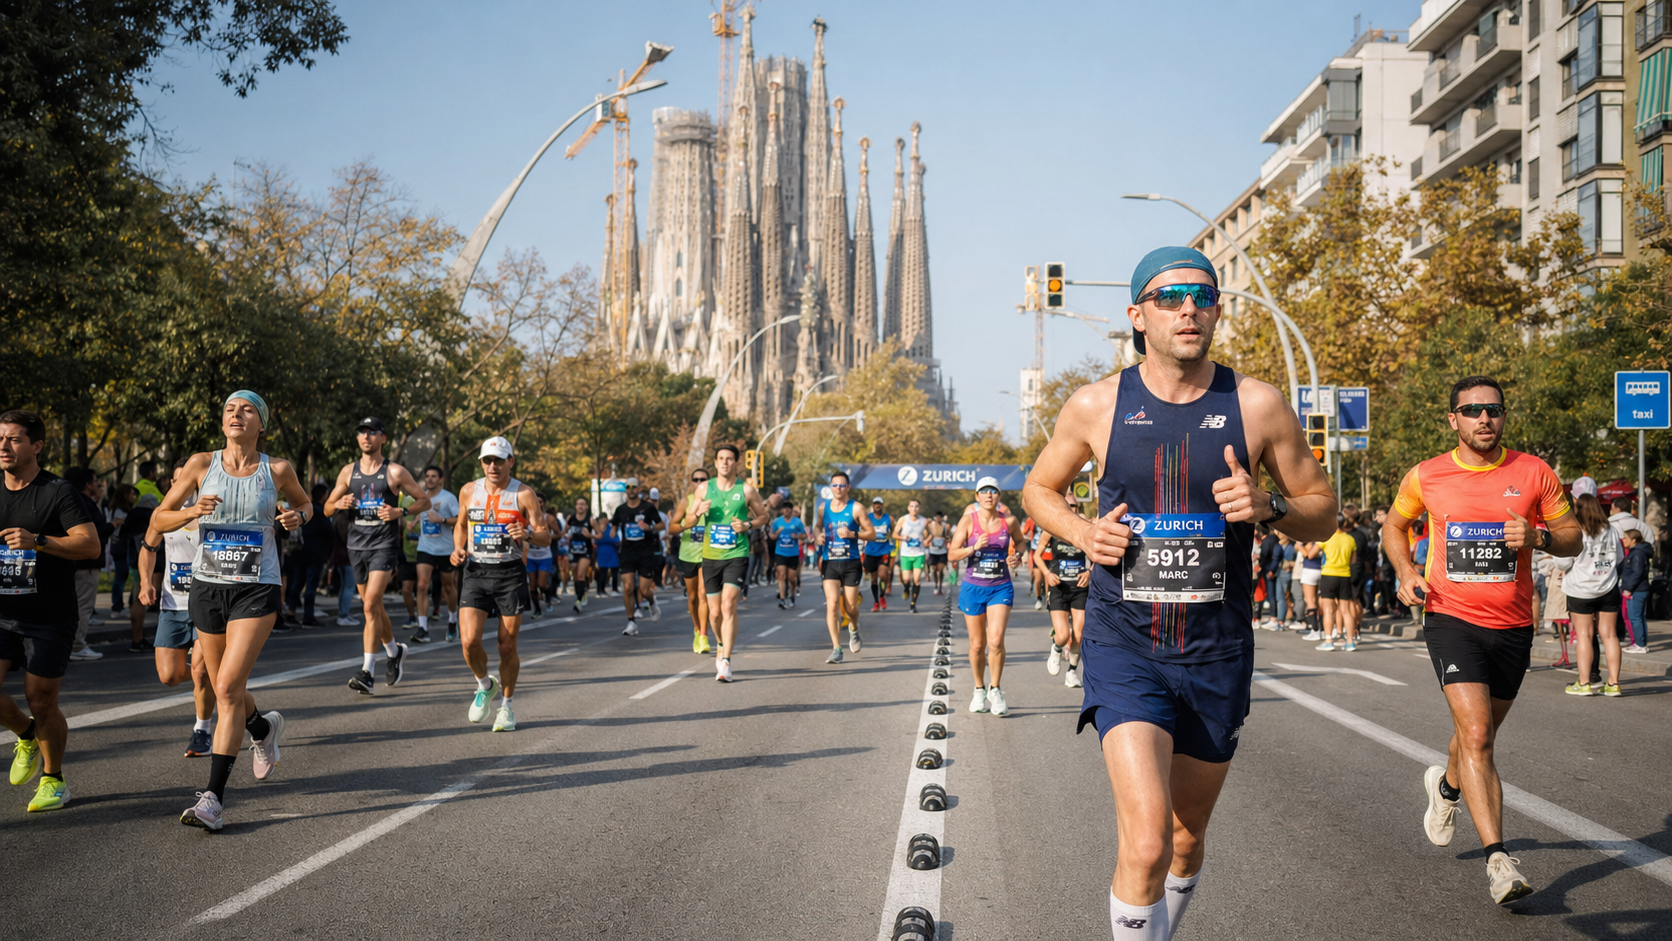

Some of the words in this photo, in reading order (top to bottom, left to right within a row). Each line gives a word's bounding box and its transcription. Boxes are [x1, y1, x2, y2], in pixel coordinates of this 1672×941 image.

[1632, 409, 1654, 419] taxi
[922, 470, 976, 482] ZURICH
[1154, 520, 1203, 531] ZURICH
[1467, 528, 1502, 536] ZURICH
[1147, 548, 1200, 567] 5912
[1460, 547, 1502, 559] 11282
[1159, 570, 1189, 580] MARC
